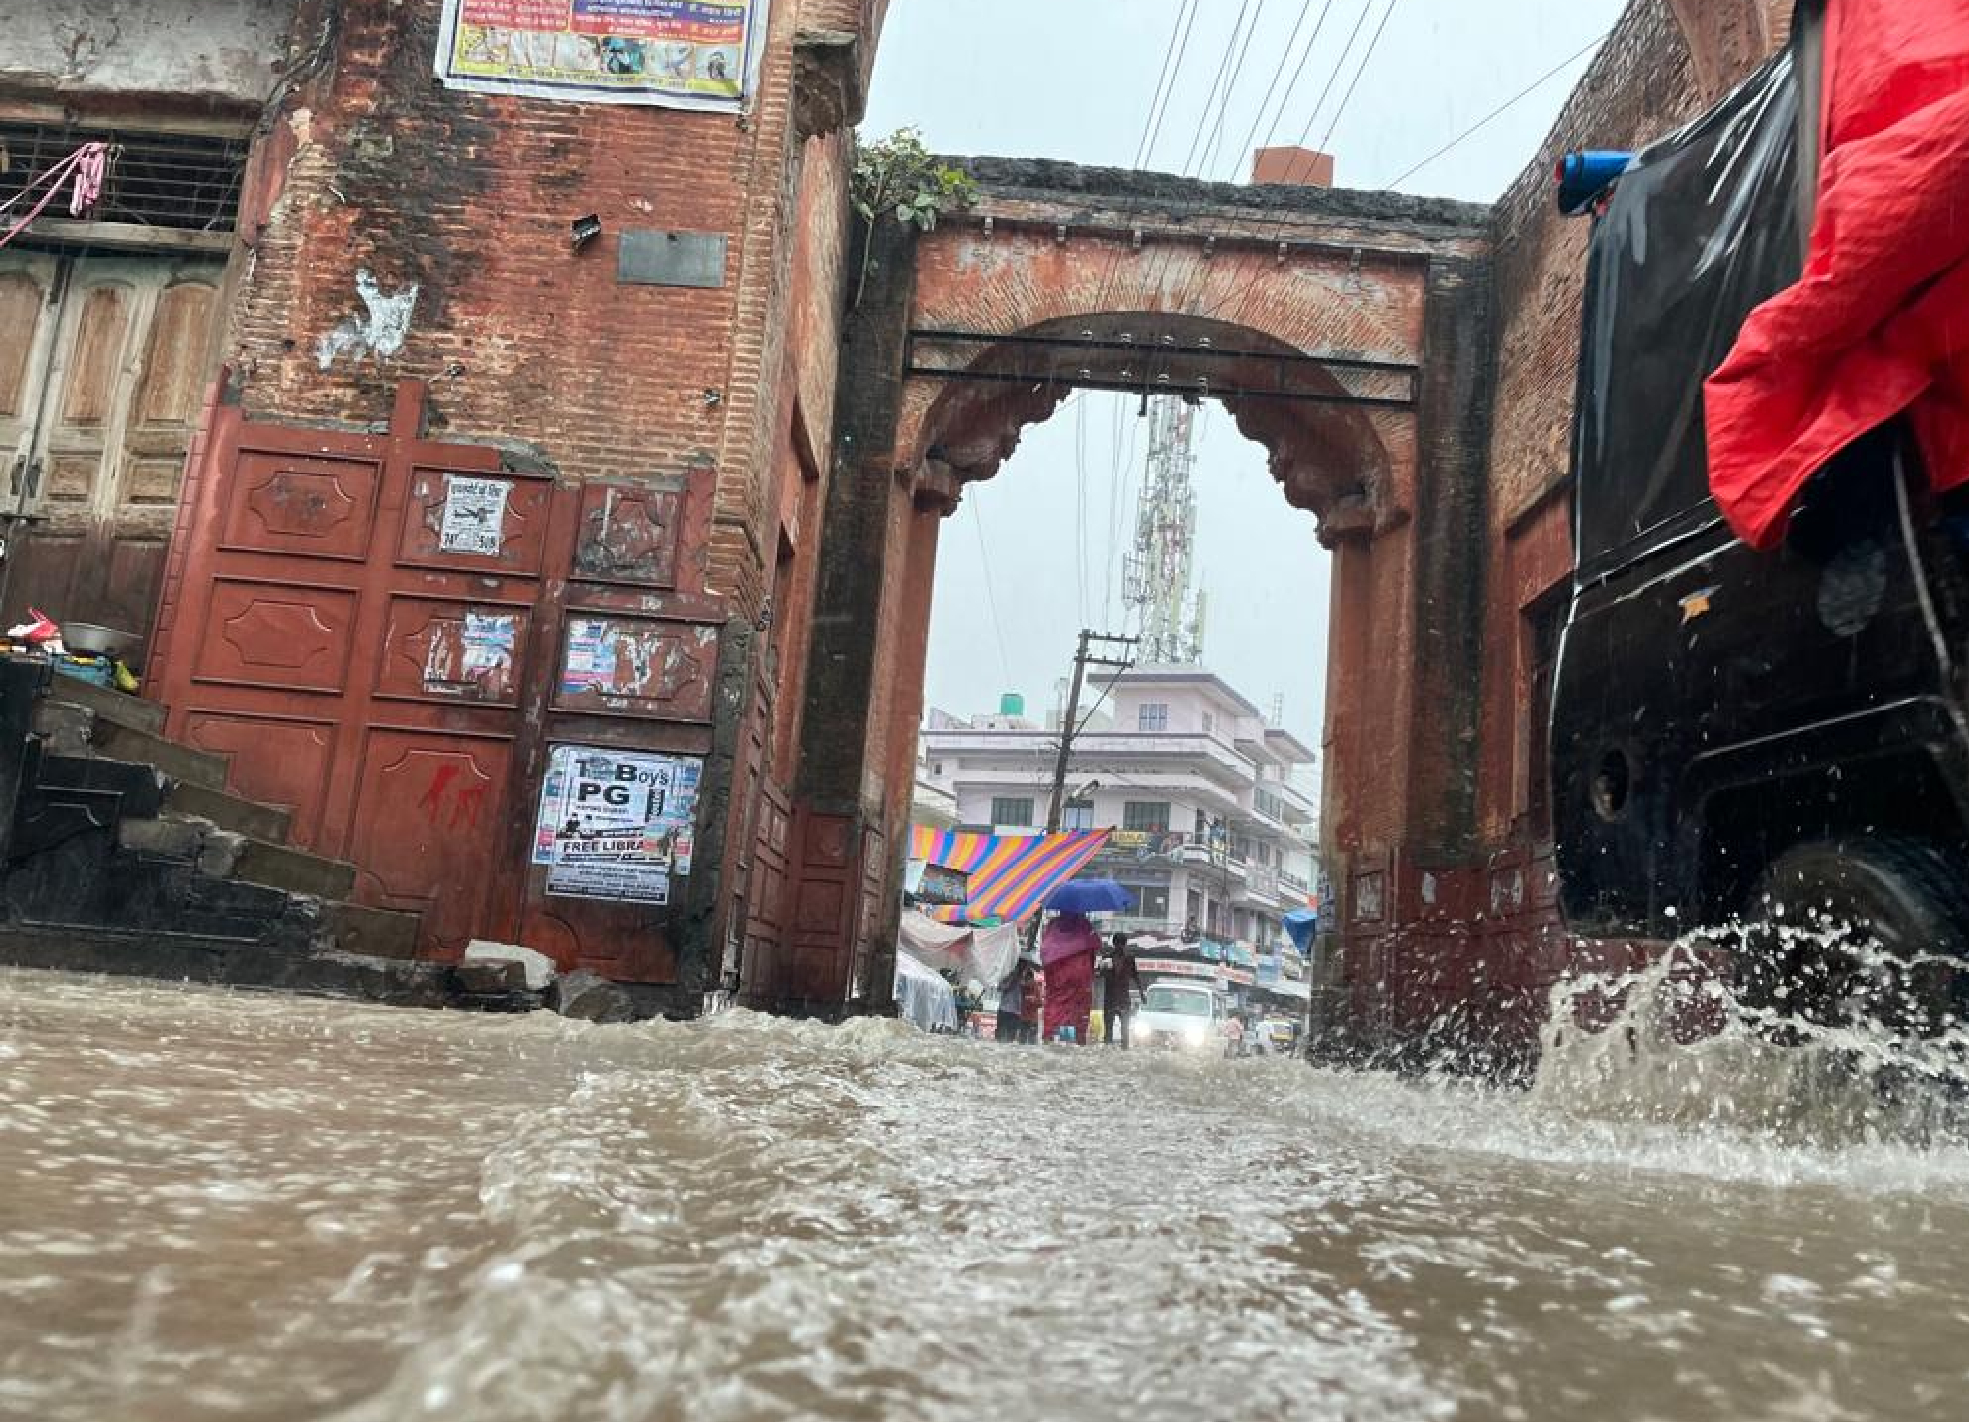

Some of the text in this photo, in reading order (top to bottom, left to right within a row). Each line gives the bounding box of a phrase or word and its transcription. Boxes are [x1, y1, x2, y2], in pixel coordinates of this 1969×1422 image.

[615, 764, 668, 787] Boys
[577, 782, 630, 805] PG
[602, 841, 643, 851] LIBRA
